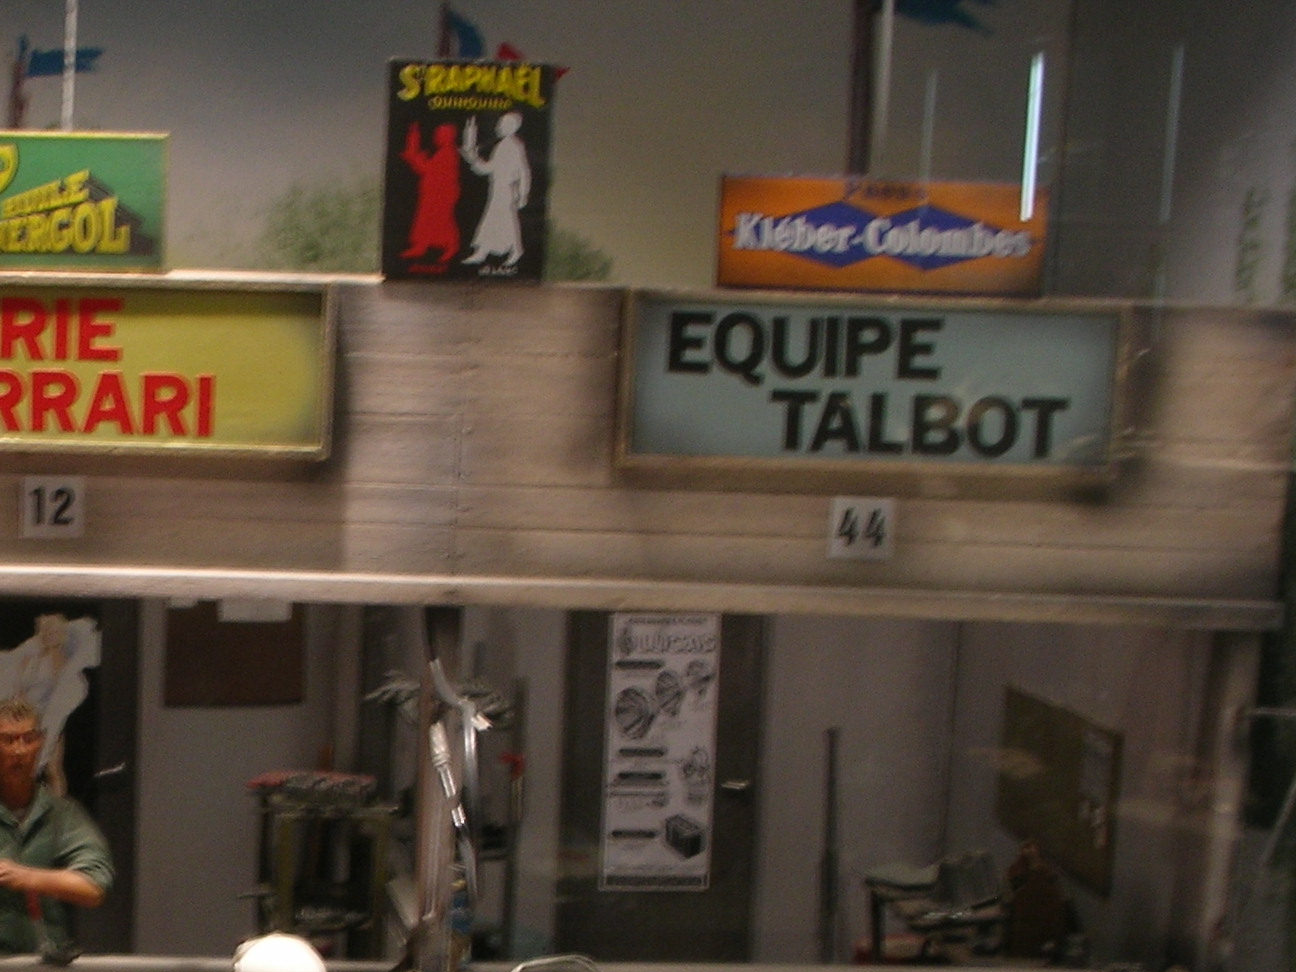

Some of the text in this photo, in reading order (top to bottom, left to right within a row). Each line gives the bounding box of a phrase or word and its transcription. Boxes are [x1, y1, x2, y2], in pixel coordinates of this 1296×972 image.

[665, 311, 945, 387] EQUIPE
[771, 389, 1071, 460] TALBOT
[27, 487, 76, 526] 12
[836, 506, 888, 548] 44
